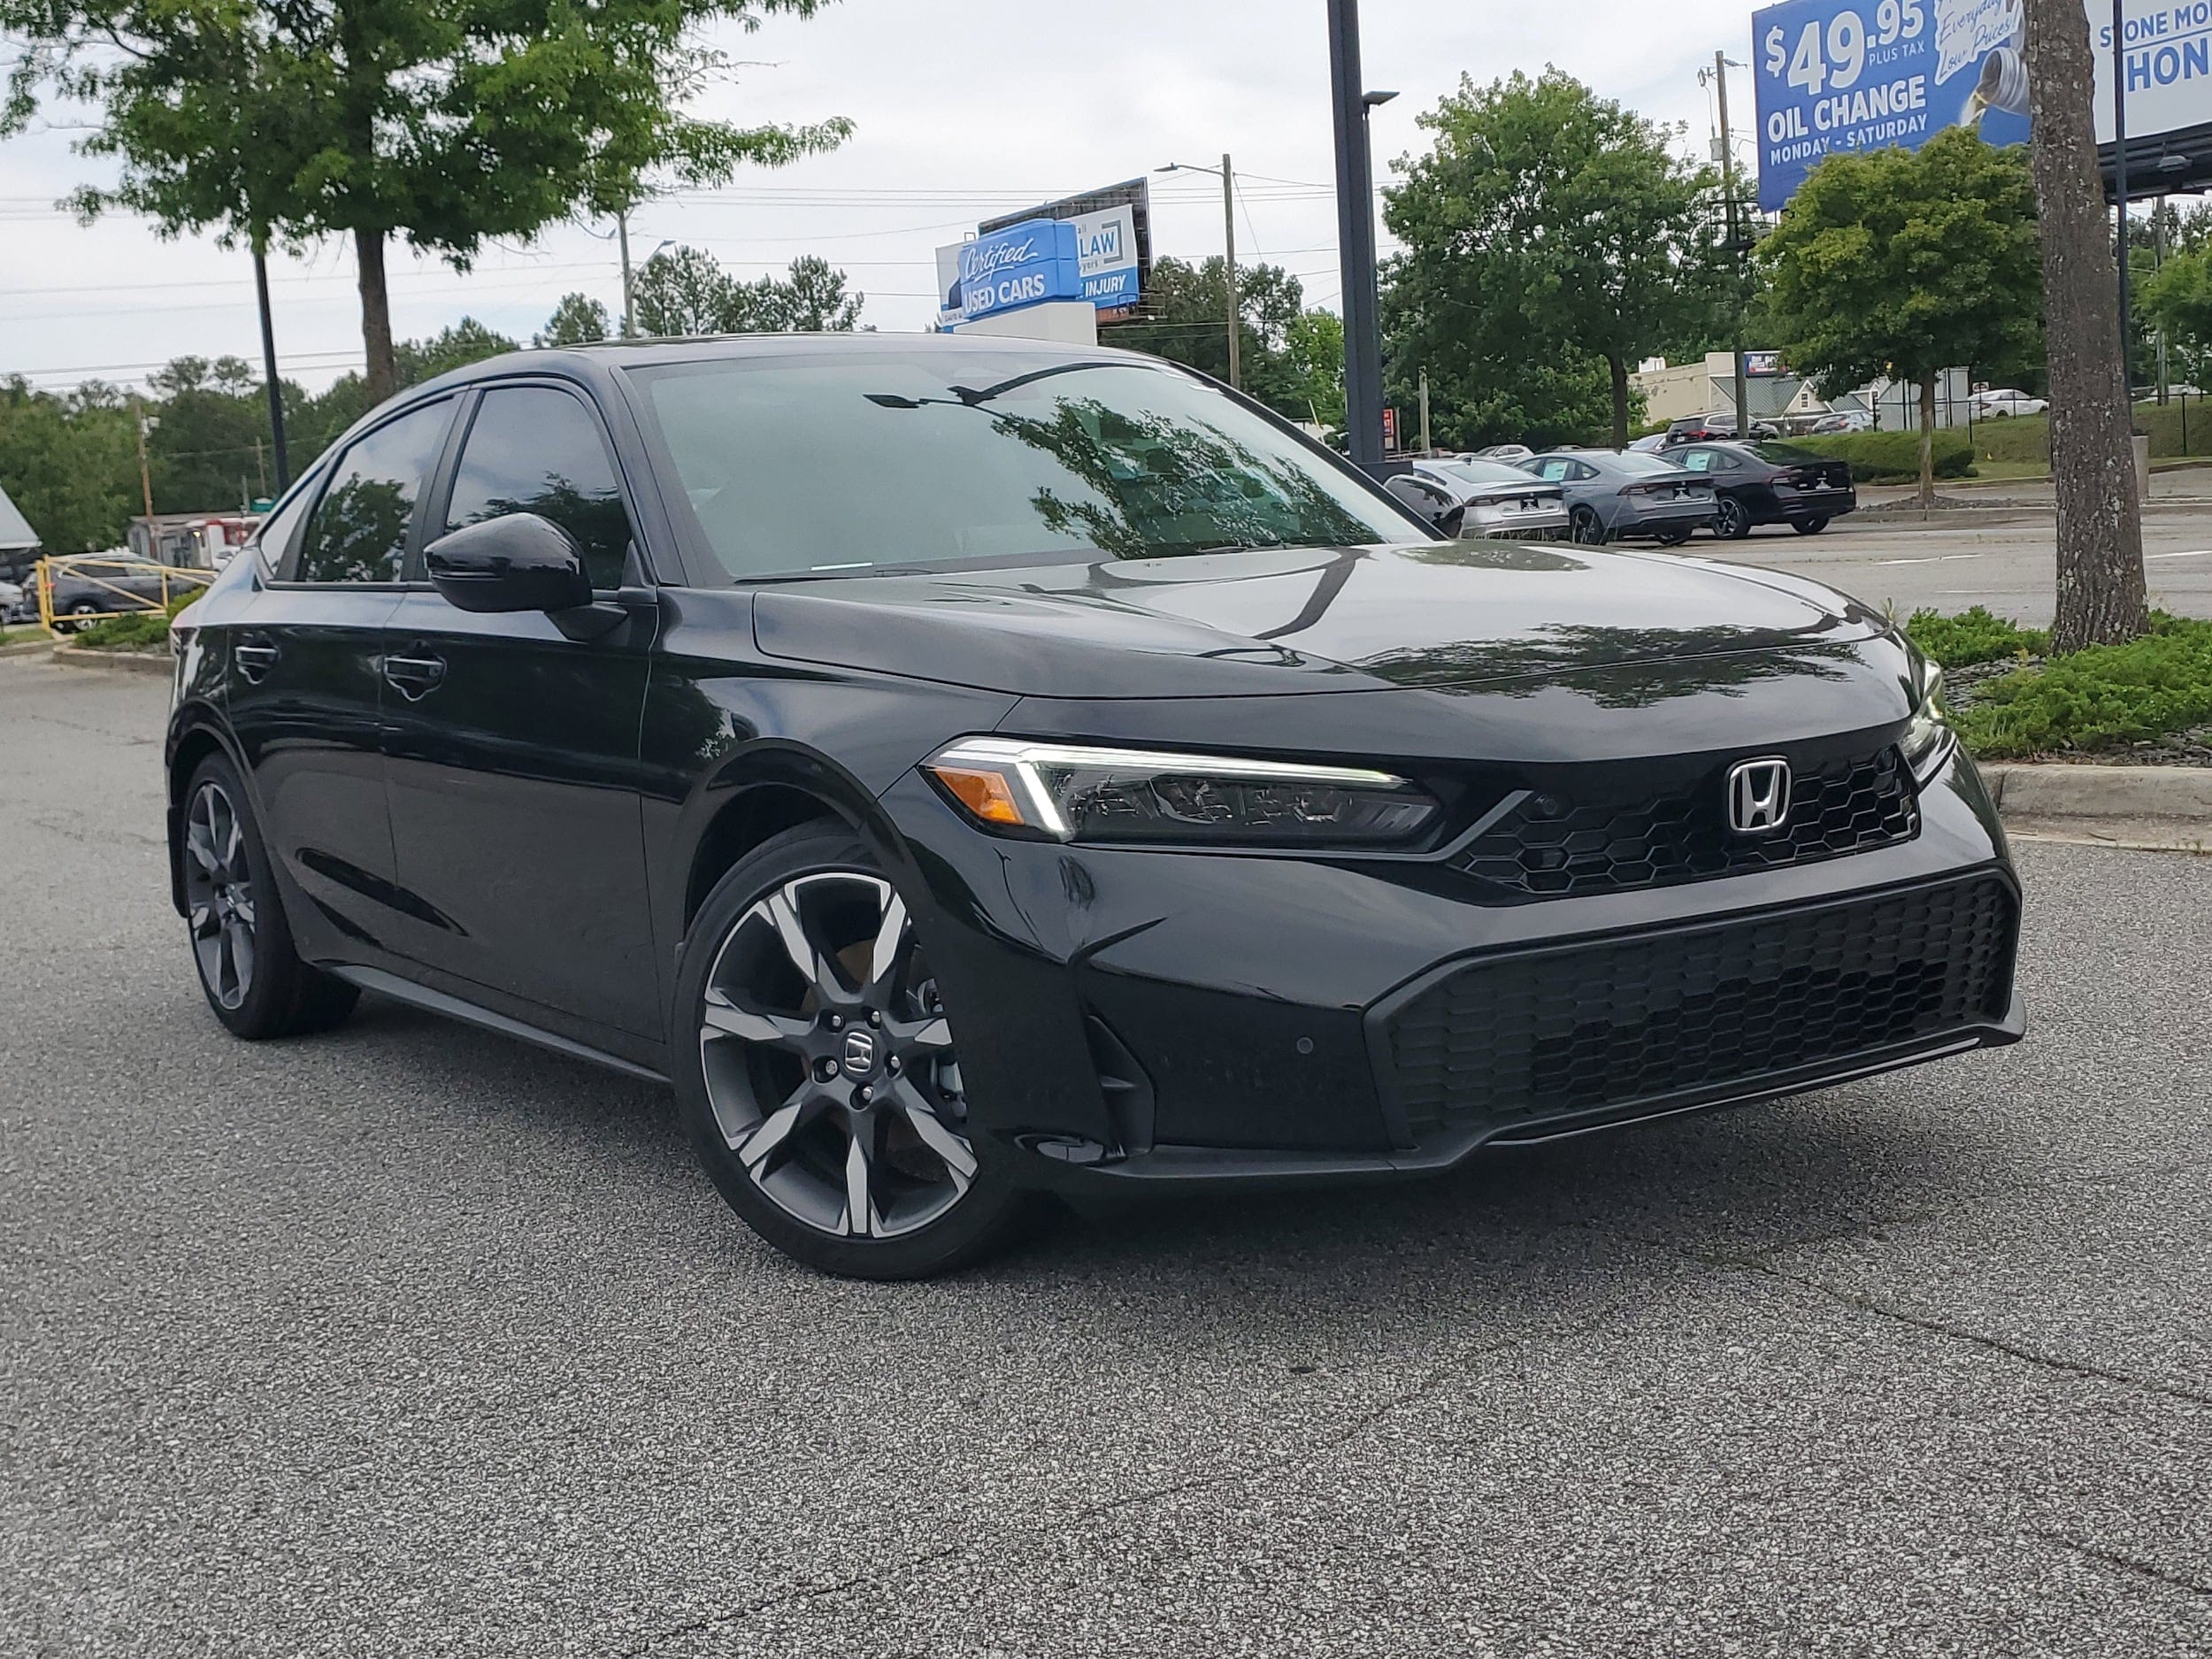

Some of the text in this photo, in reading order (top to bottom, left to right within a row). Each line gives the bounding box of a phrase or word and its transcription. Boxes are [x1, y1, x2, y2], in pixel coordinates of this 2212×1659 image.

[2100, 1, 2212, 48] SONE MO
[1869, 41, 1925, 66] PLUS TAX
[1939, 50, 1968, 80] Low
[1768, 75, 1926, 142] OIL CHANGE
[1770, 136, 1830, 166] MONDAY
[1846, 113, 1927, 148] SATURDAY
[965, 237, 1039, 282] Certified
[1080, 231, 1114, 257] LAW
[1079, 260, 1099, 273] yers
[965, 286, 995, 313] USED
[998, 273, 1045, 304] CARS
[1085, 275, 1126, 298] INJURY
